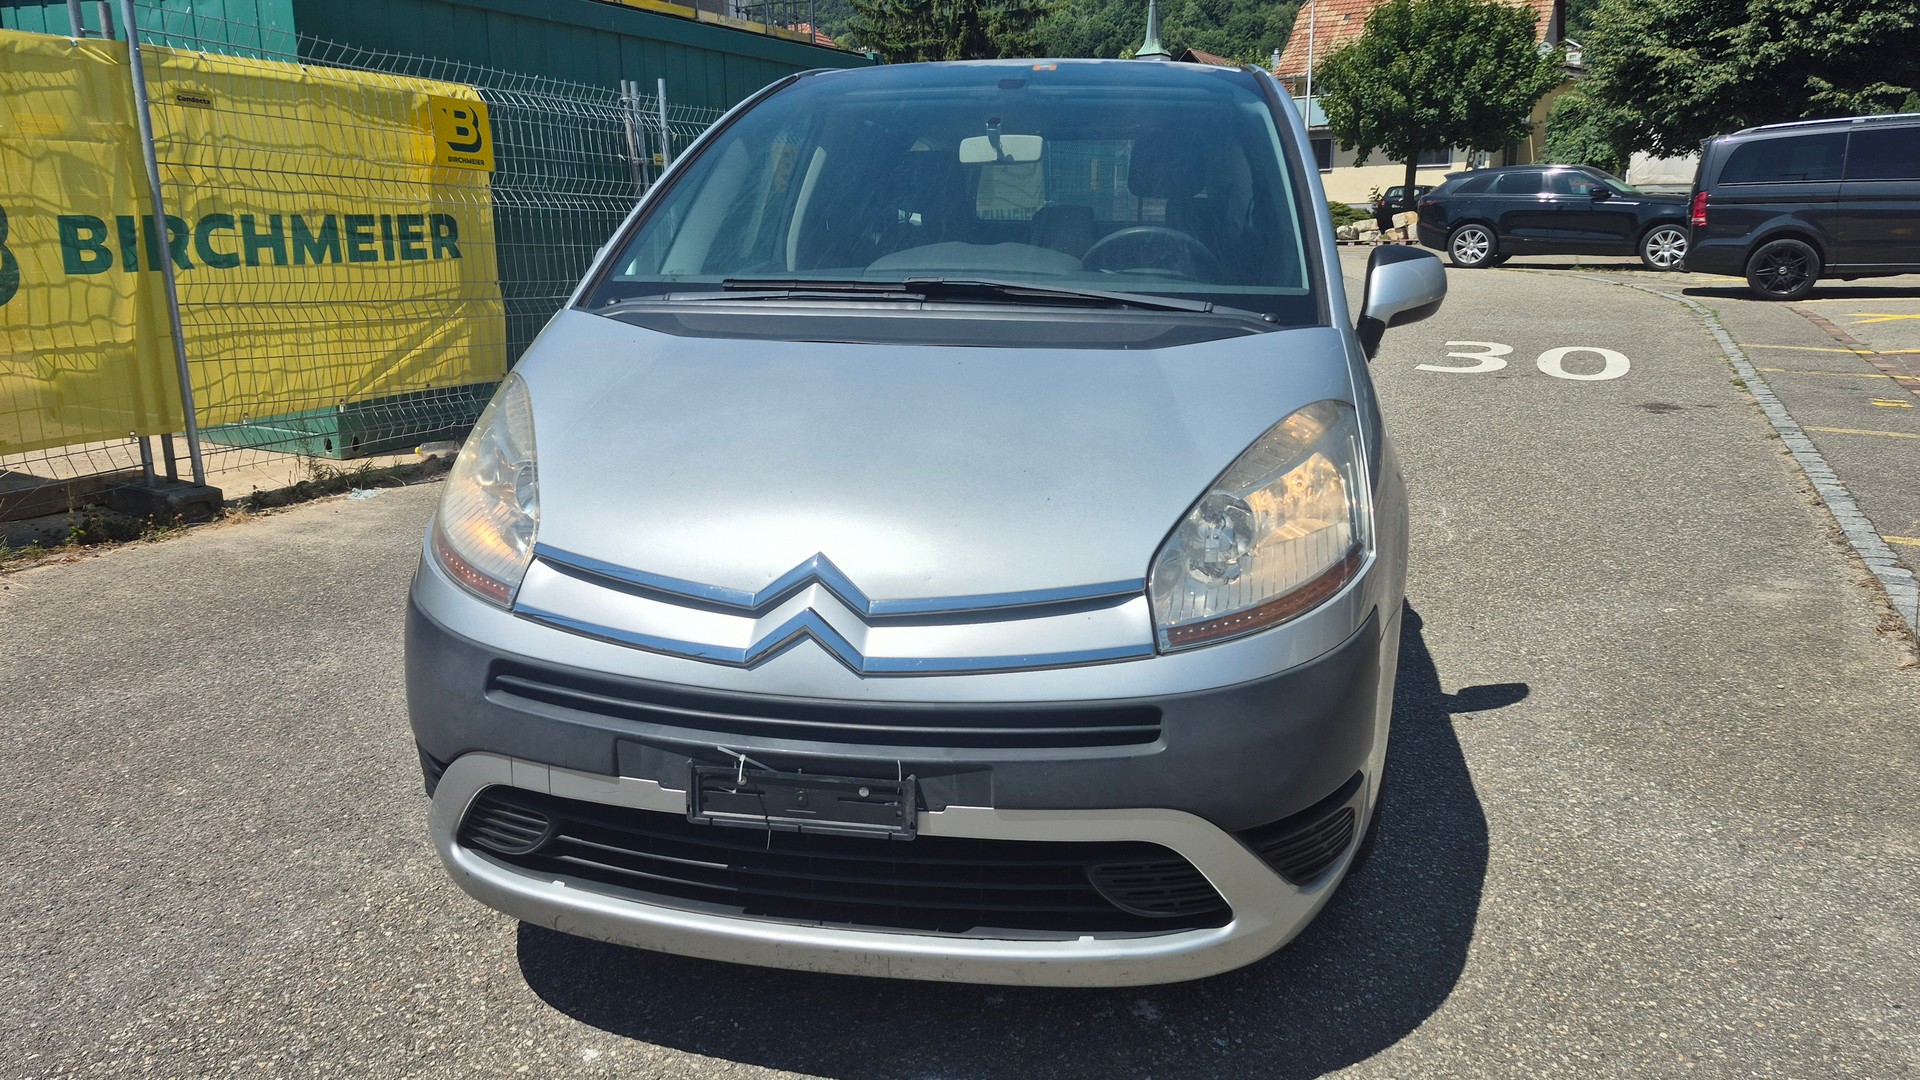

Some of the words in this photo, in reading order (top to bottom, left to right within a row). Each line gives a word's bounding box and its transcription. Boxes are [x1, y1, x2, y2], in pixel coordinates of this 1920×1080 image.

[176, 94, 211, 104] Condecta
[447, 155, 485, 166] BIRCHMEIER
[57, 212, 463, 274] BIRCHMEIER
[1414, 340, 1631, 381] 30
